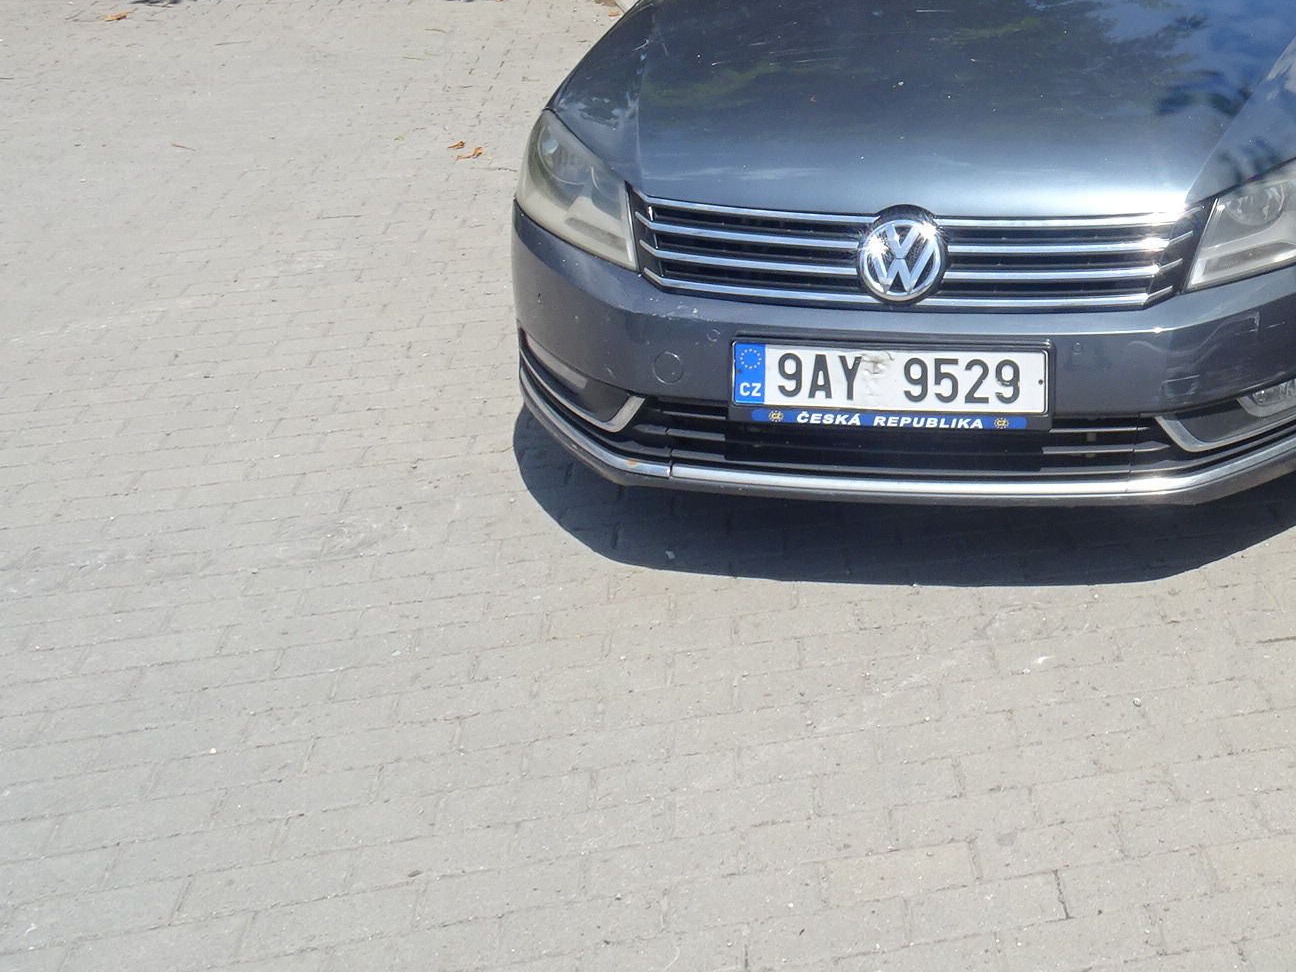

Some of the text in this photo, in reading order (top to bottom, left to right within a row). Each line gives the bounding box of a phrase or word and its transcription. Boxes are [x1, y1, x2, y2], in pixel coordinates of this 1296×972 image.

[777, 352, 1021, 405] 9AY 9529
[739, 381, 763, 397] CZ
[796, 411, 984, 429] ČESKÁ REPUBLIKA
